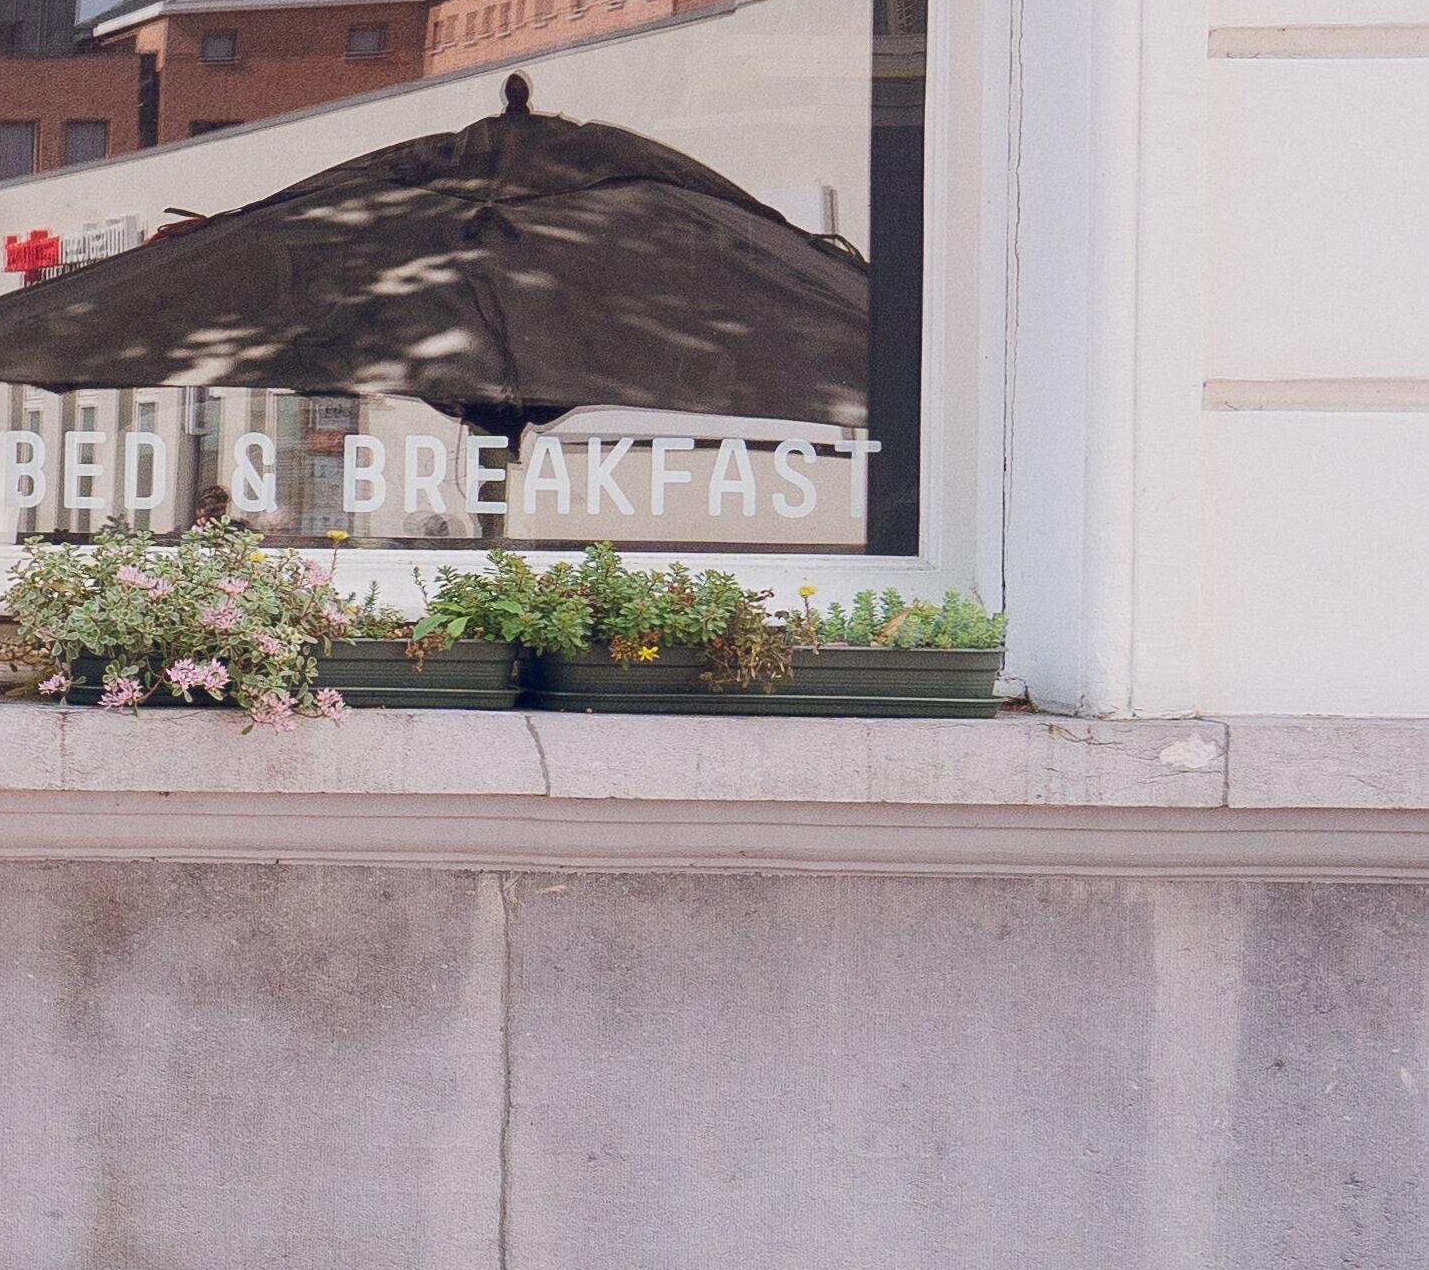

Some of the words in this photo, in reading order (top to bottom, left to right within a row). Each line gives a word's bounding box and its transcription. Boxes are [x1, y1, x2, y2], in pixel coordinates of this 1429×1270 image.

[4, 430, 168, 511] BED
[232, 431, 279, 513] &
[343, 433, 883, 520] BREAKFAST
